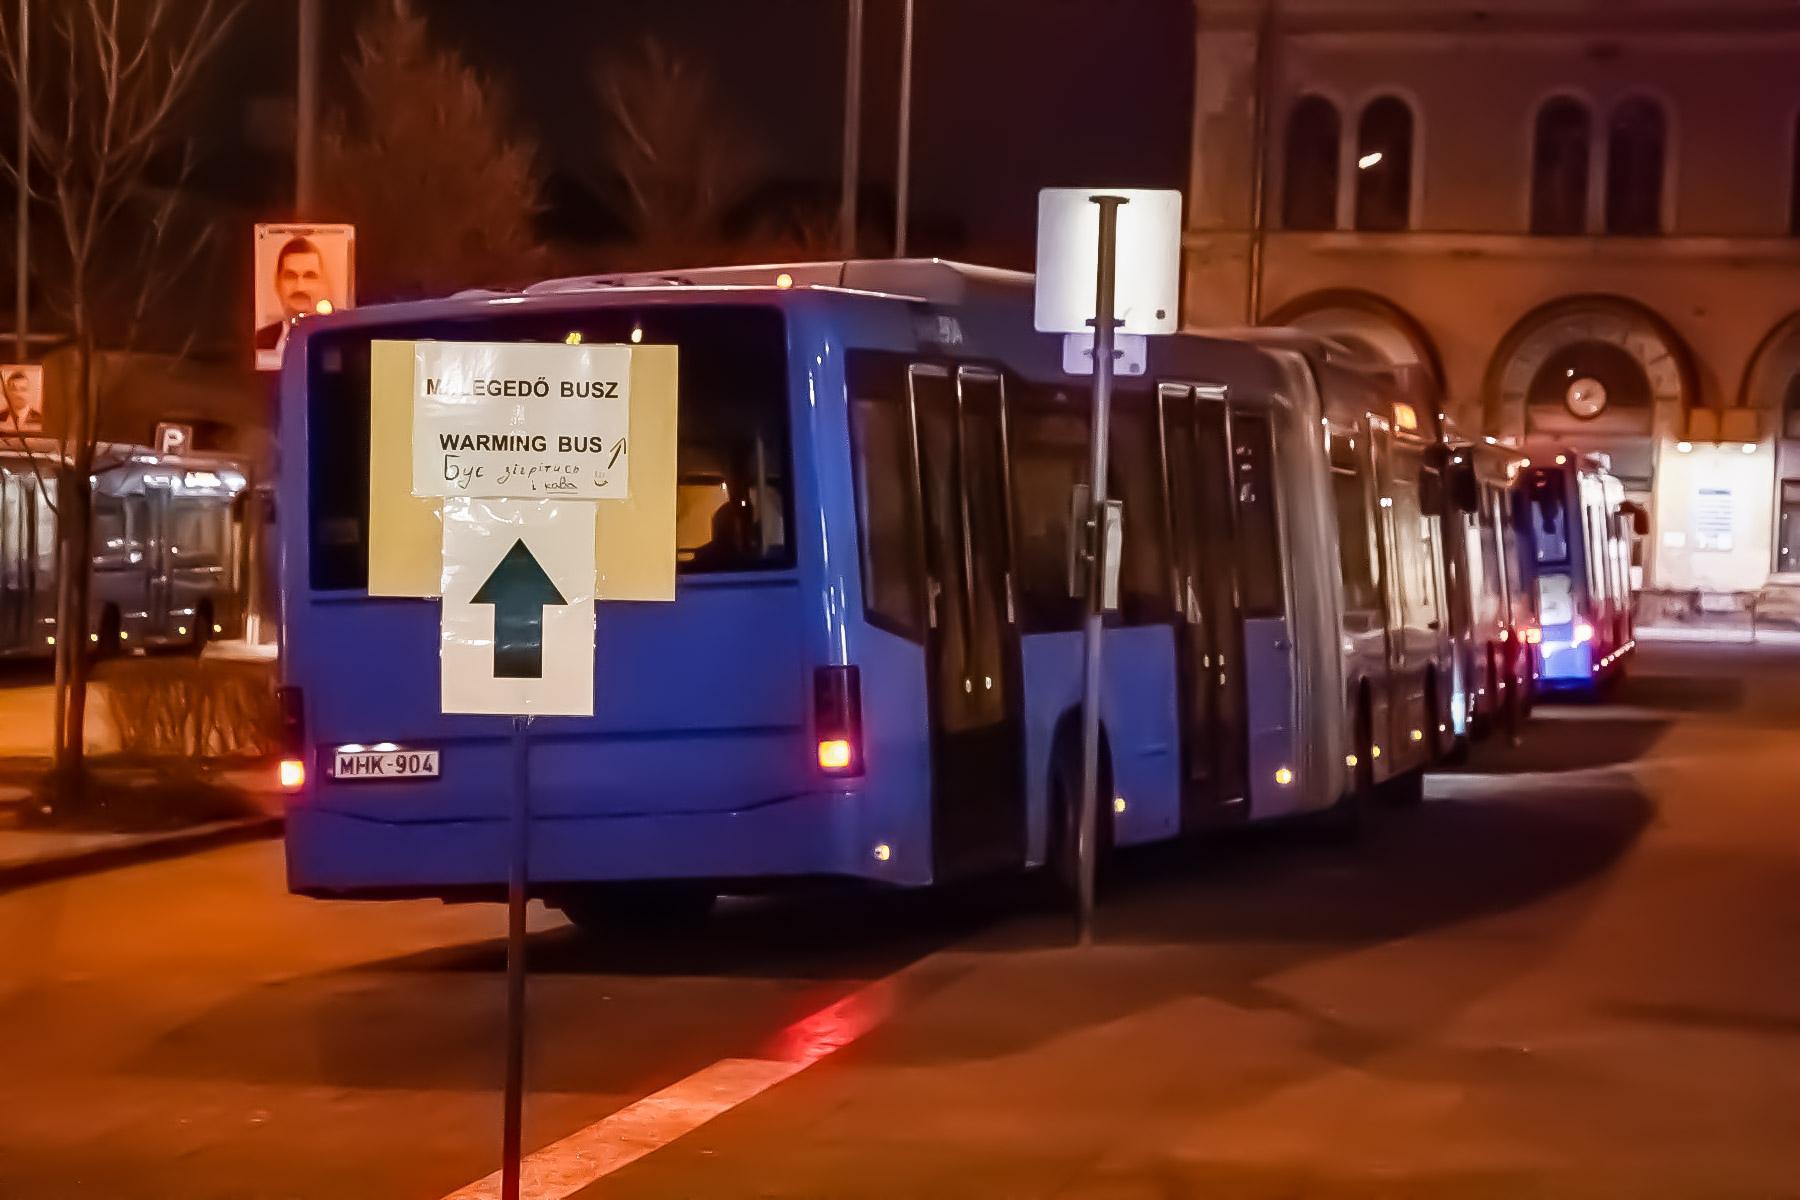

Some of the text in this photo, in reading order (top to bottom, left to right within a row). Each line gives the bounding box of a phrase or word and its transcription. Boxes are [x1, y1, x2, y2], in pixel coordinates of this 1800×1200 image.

[426, 376, 619, 399] MEGEDŐ BUSZ
[163, 430, 185, 453] P
[439, 433, 602, 453] WARMING BUS
[444, 454, 484, 489] Бус
[340, 754, 433, 774] MHK-904
